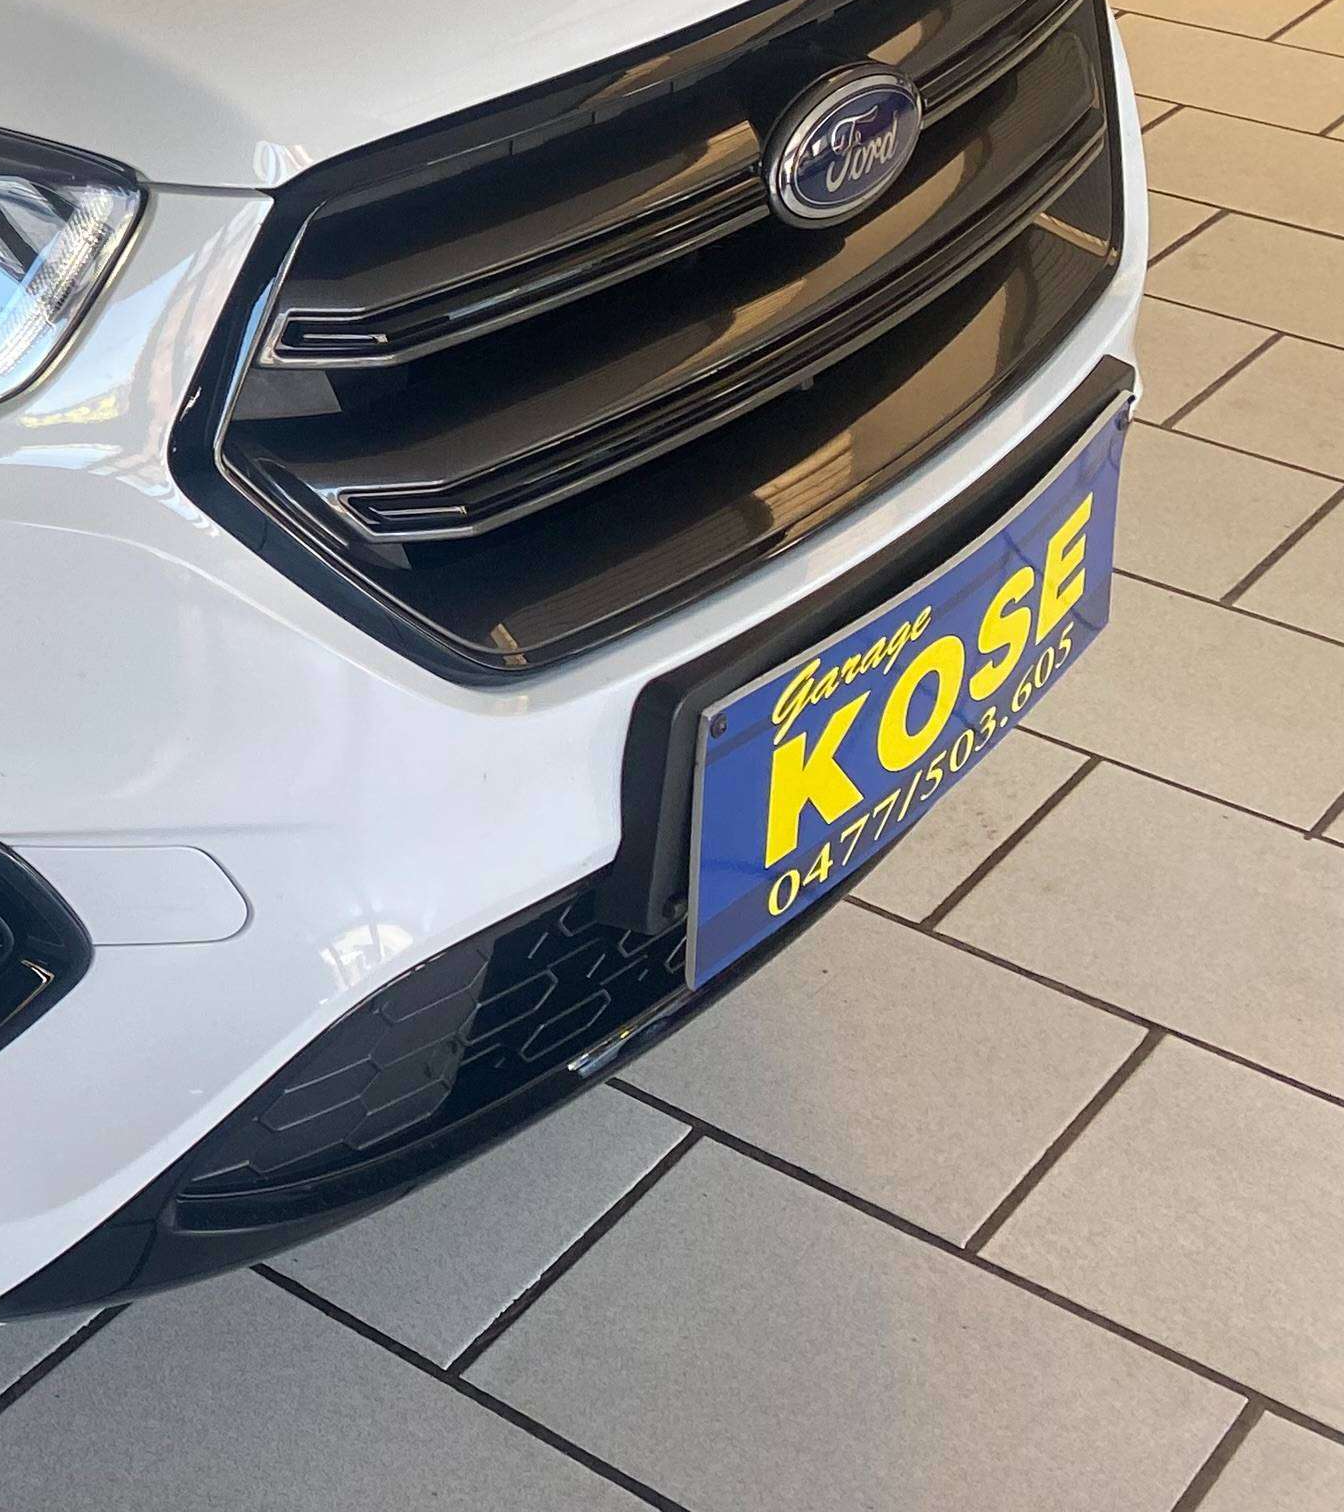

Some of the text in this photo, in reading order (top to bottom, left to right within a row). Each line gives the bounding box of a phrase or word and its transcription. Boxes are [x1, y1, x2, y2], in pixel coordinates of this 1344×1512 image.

[826, 104, 899, 193] Ford
[764, 491, 1094, 869] KOSE
[767, 621, 1075, 917] 0477/503.605
[770, 604, 933, 745] Garage
